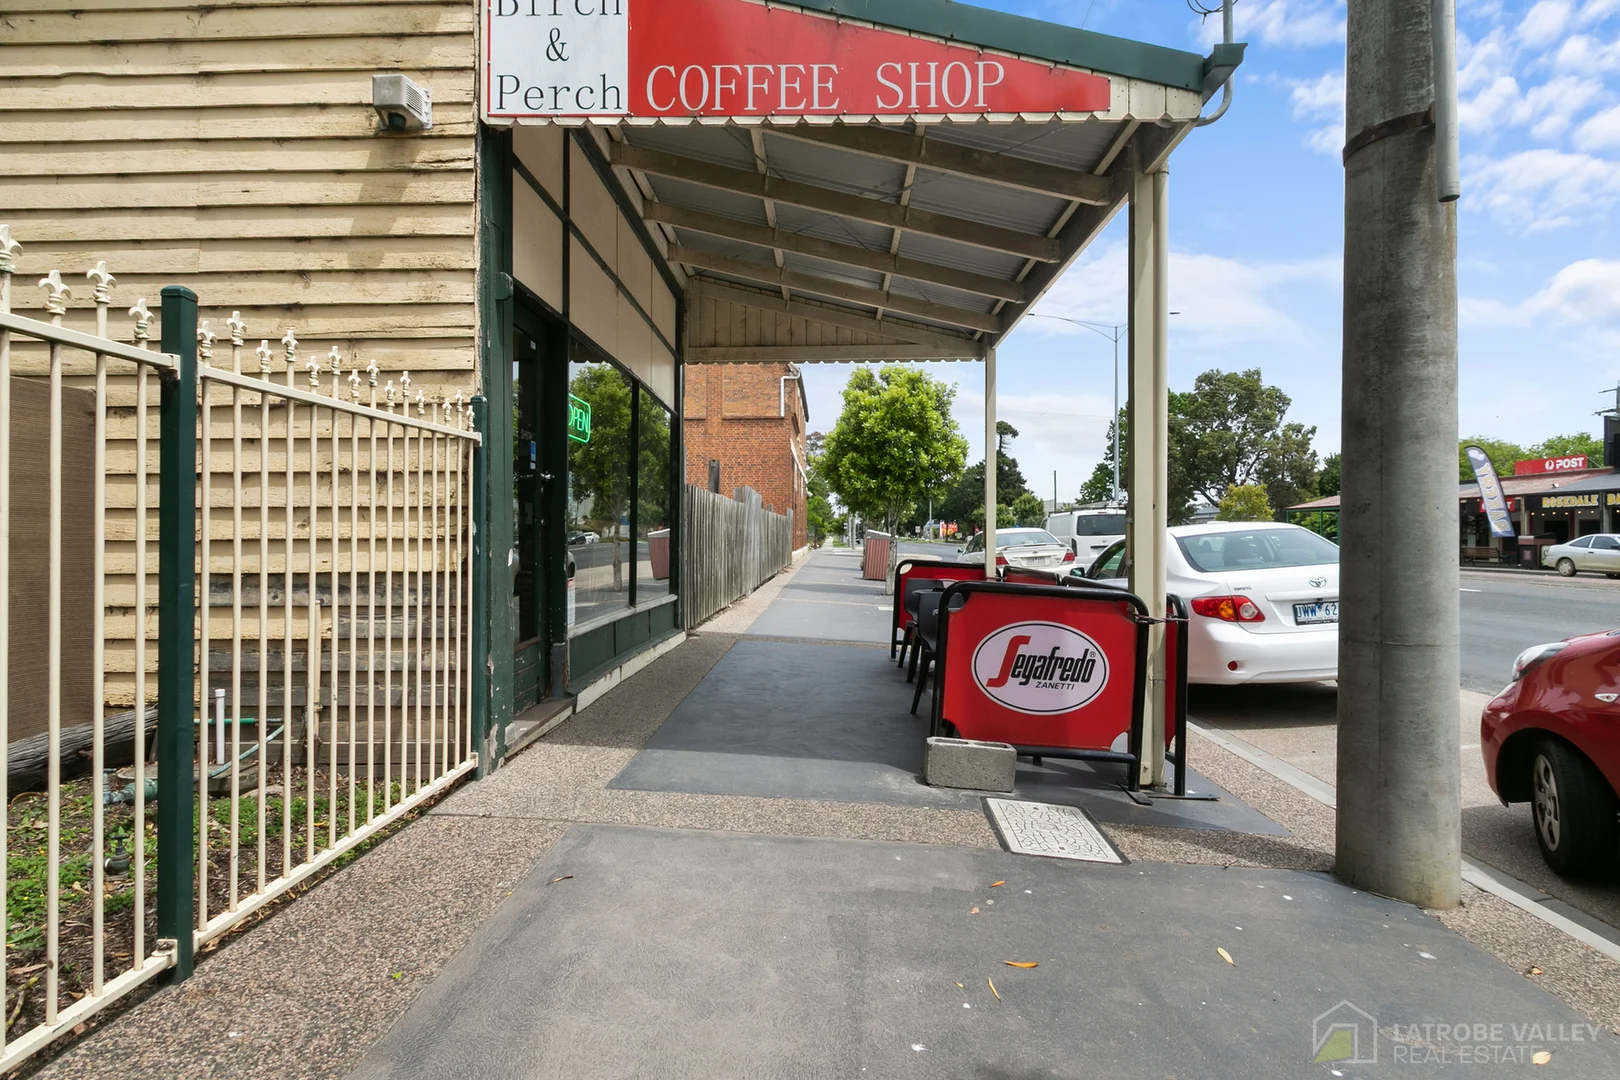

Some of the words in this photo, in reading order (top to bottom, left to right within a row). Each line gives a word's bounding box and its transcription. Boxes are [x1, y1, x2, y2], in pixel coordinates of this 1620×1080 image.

[546, 27, 570, 61] &
[495, 73, 622, 110] Perch
[646, 63, 840, 112] COFFEE
[876, 60, 1005, 110] SHOP
[1556, 458, 1584, 468] POST
[1542, 494, 1598, 507] ROSEDALE
[1035, 681, 1075, 691] ZANETTI
